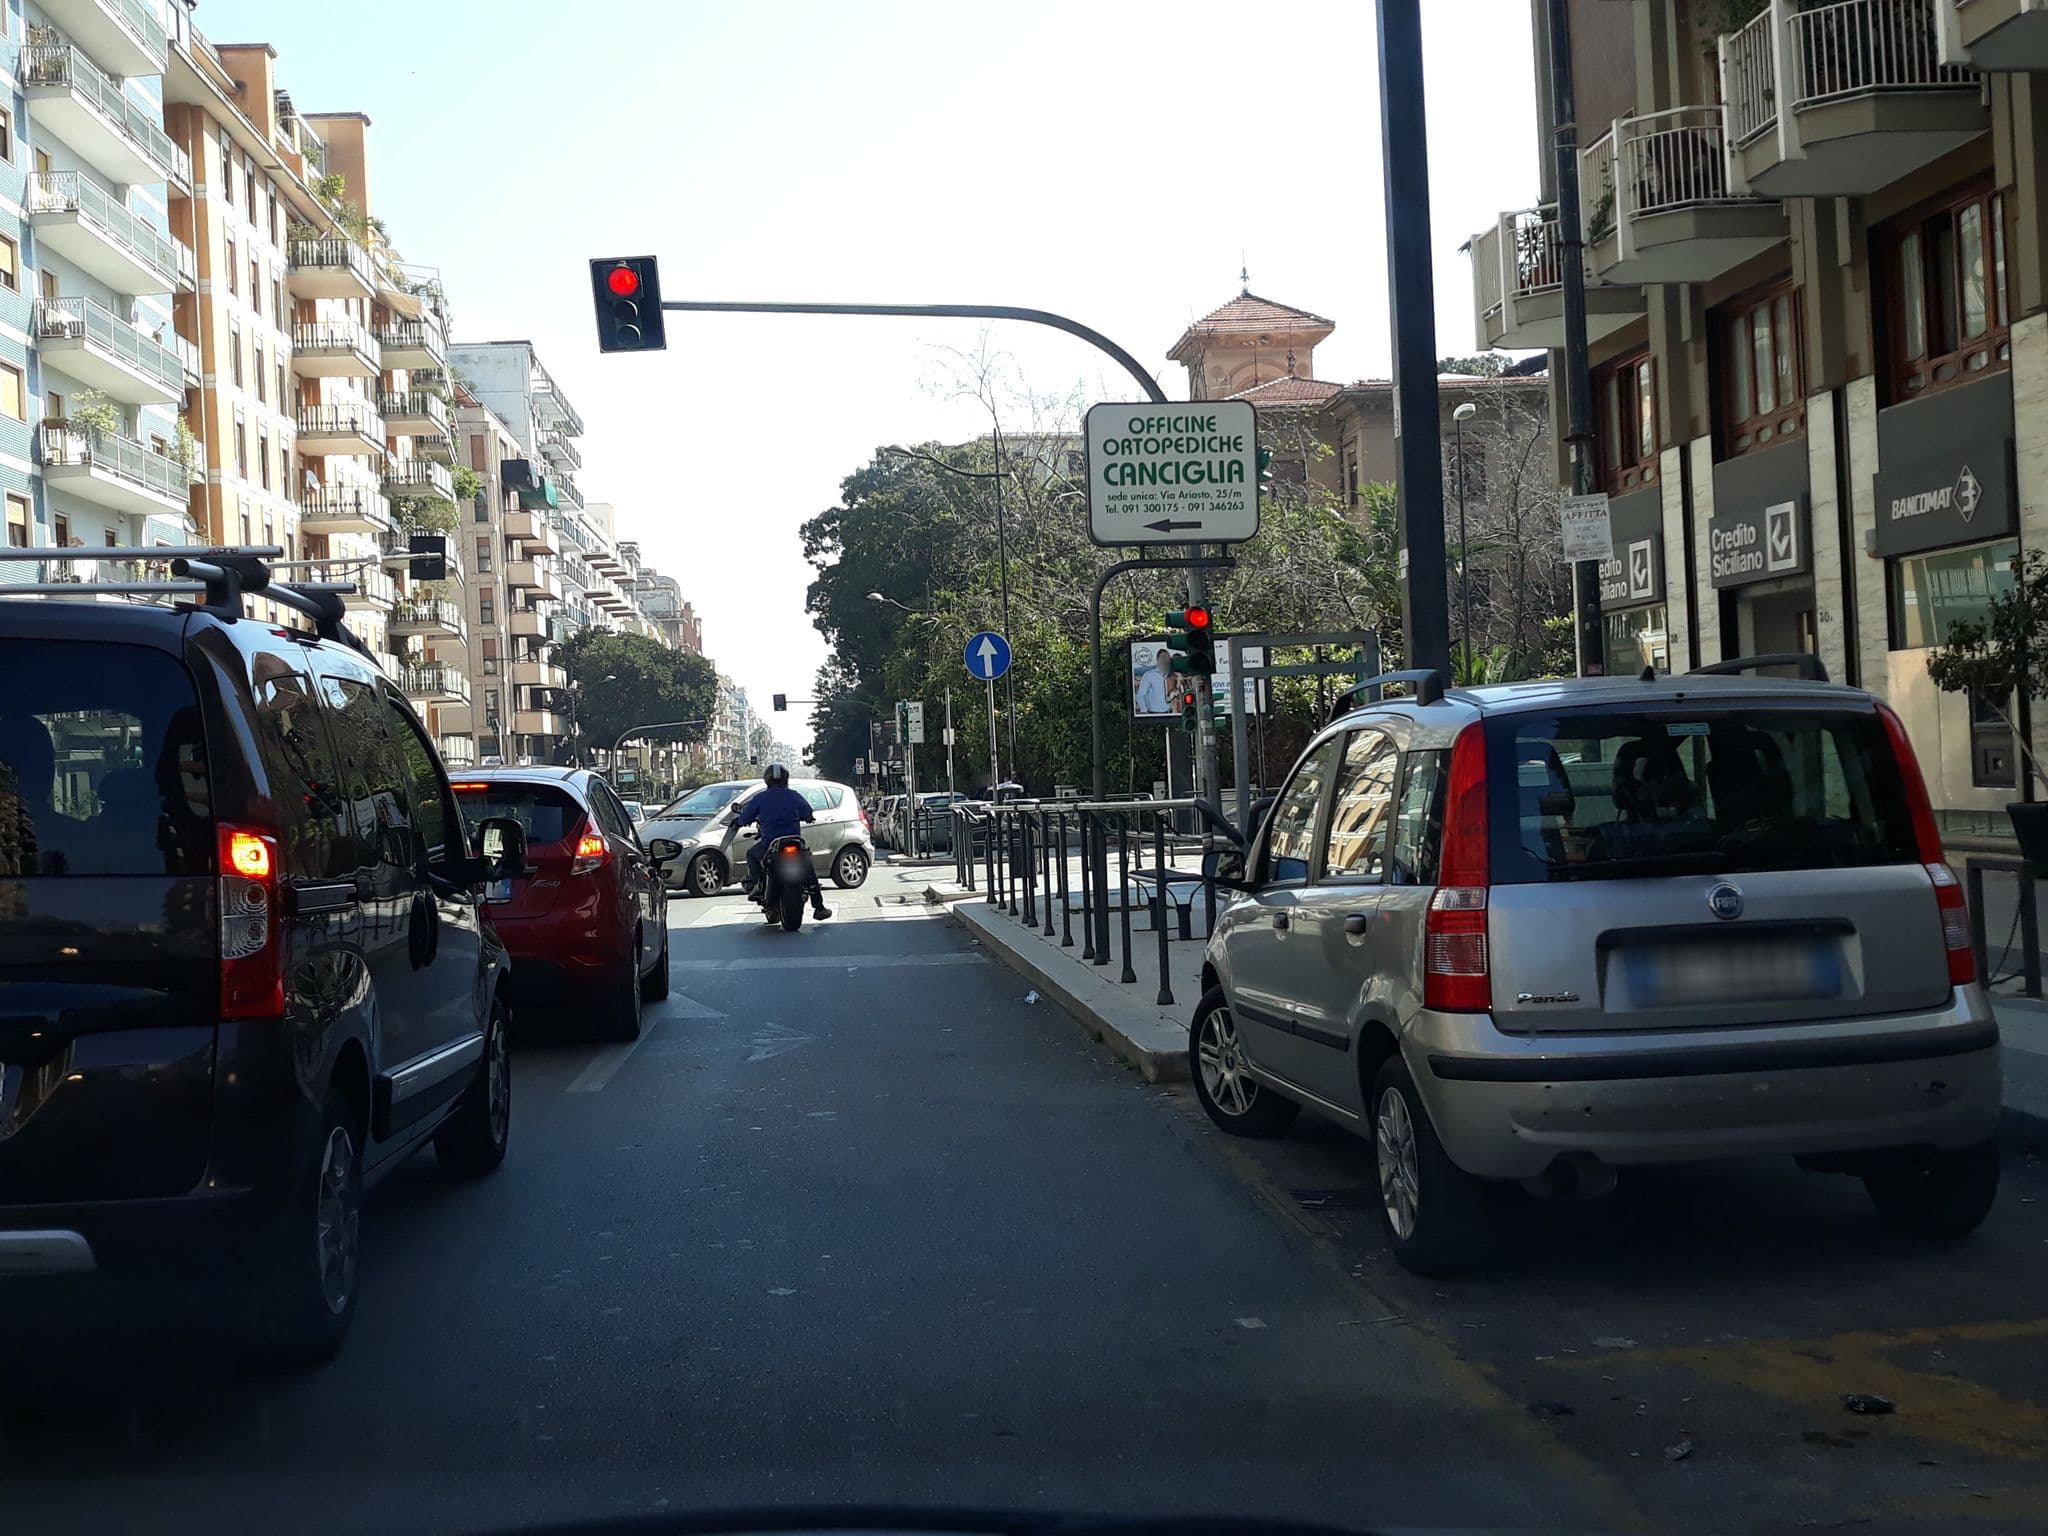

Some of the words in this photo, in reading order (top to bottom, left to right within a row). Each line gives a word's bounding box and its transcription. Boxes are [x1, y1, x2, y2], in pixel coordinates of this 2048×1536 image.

[1128, 415, 1217, 435] OFFICINE
[1102, 435, 1243, 456] ORTOPEDICHE
[1103, 459, 1244, 487] CANCIGLIA
[1107, 490, 1128, 501] sede
[1160, 490, 1176, 500] Via
[1178, 488, 1213, 500] Ariosto,
[1216, 487, 1242, 499] 25/m
[1892, 486, 1953, 520] BANCOMAT
[1105, 503, 1120, 514] Tel.
[1122, 503, 1140, 514] 091
[1143, 502, 1179, 513] 300175
[1187, 502, 1205, 512] 091
[1208, 500, 1245, 511] 346263
[1562, 508, 1608, 521] AFFITTA
[1711, 522, 1757, 552] Credito
[1598, 559, 1623, 579] edito
[1712, 550, 1764, 578] Siciliano
[1715, 896, 1737, 908] FIAT
[1517, 991, 1580, 1004] Panda
